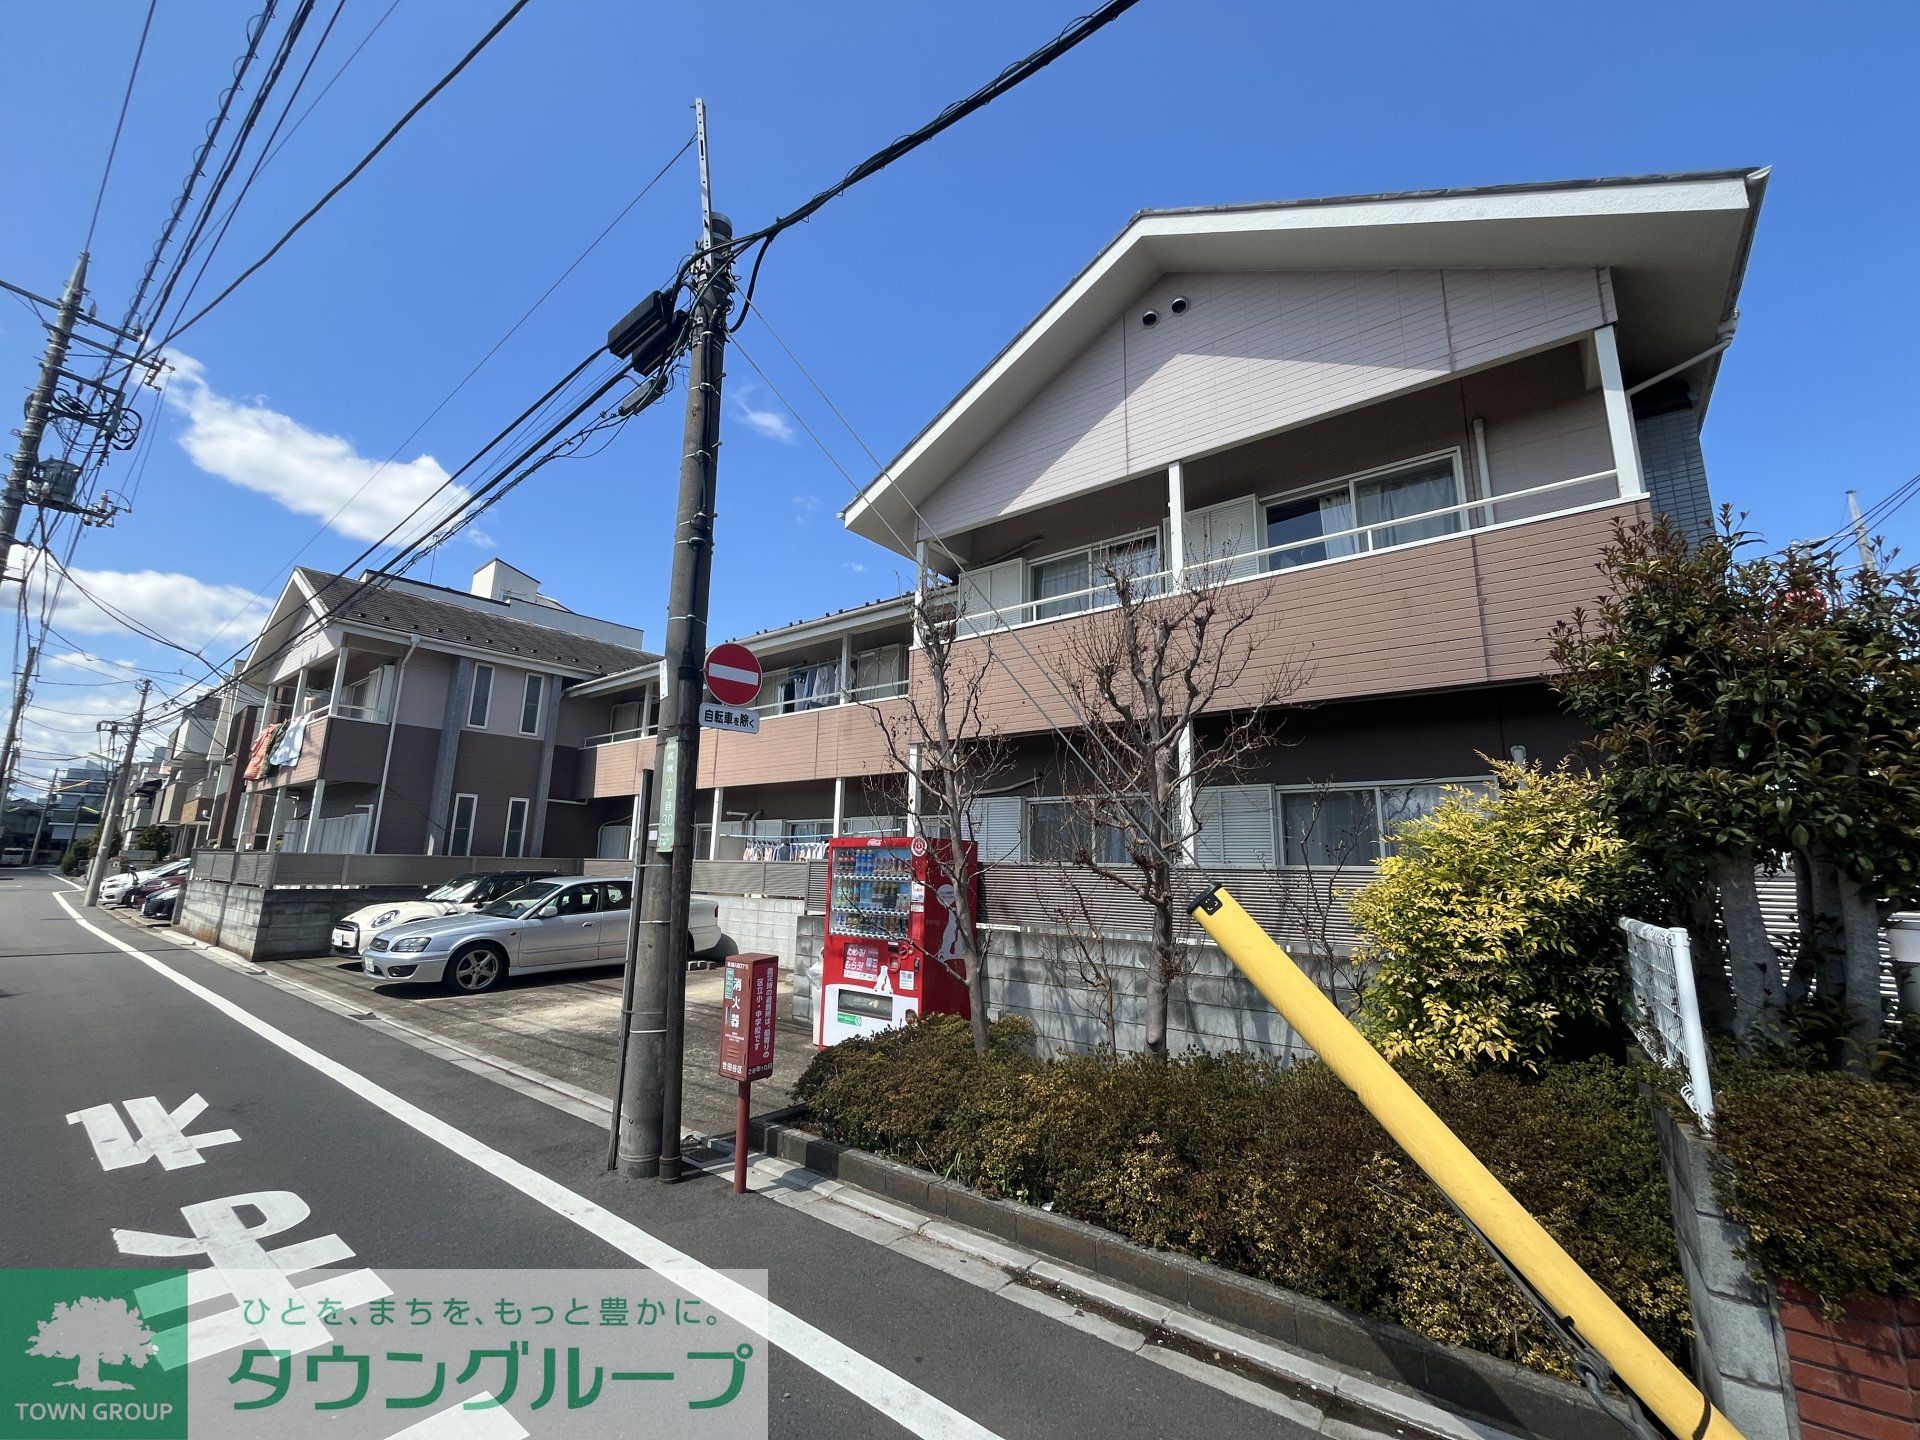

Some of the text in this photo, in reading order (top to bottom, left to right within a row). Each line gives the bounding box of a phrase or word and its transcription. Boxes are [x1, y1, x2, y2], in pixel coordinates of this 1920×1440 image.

[704, 708, 755, 728] 自転車を除く
[731, 977, 742, 1028] 消火器
